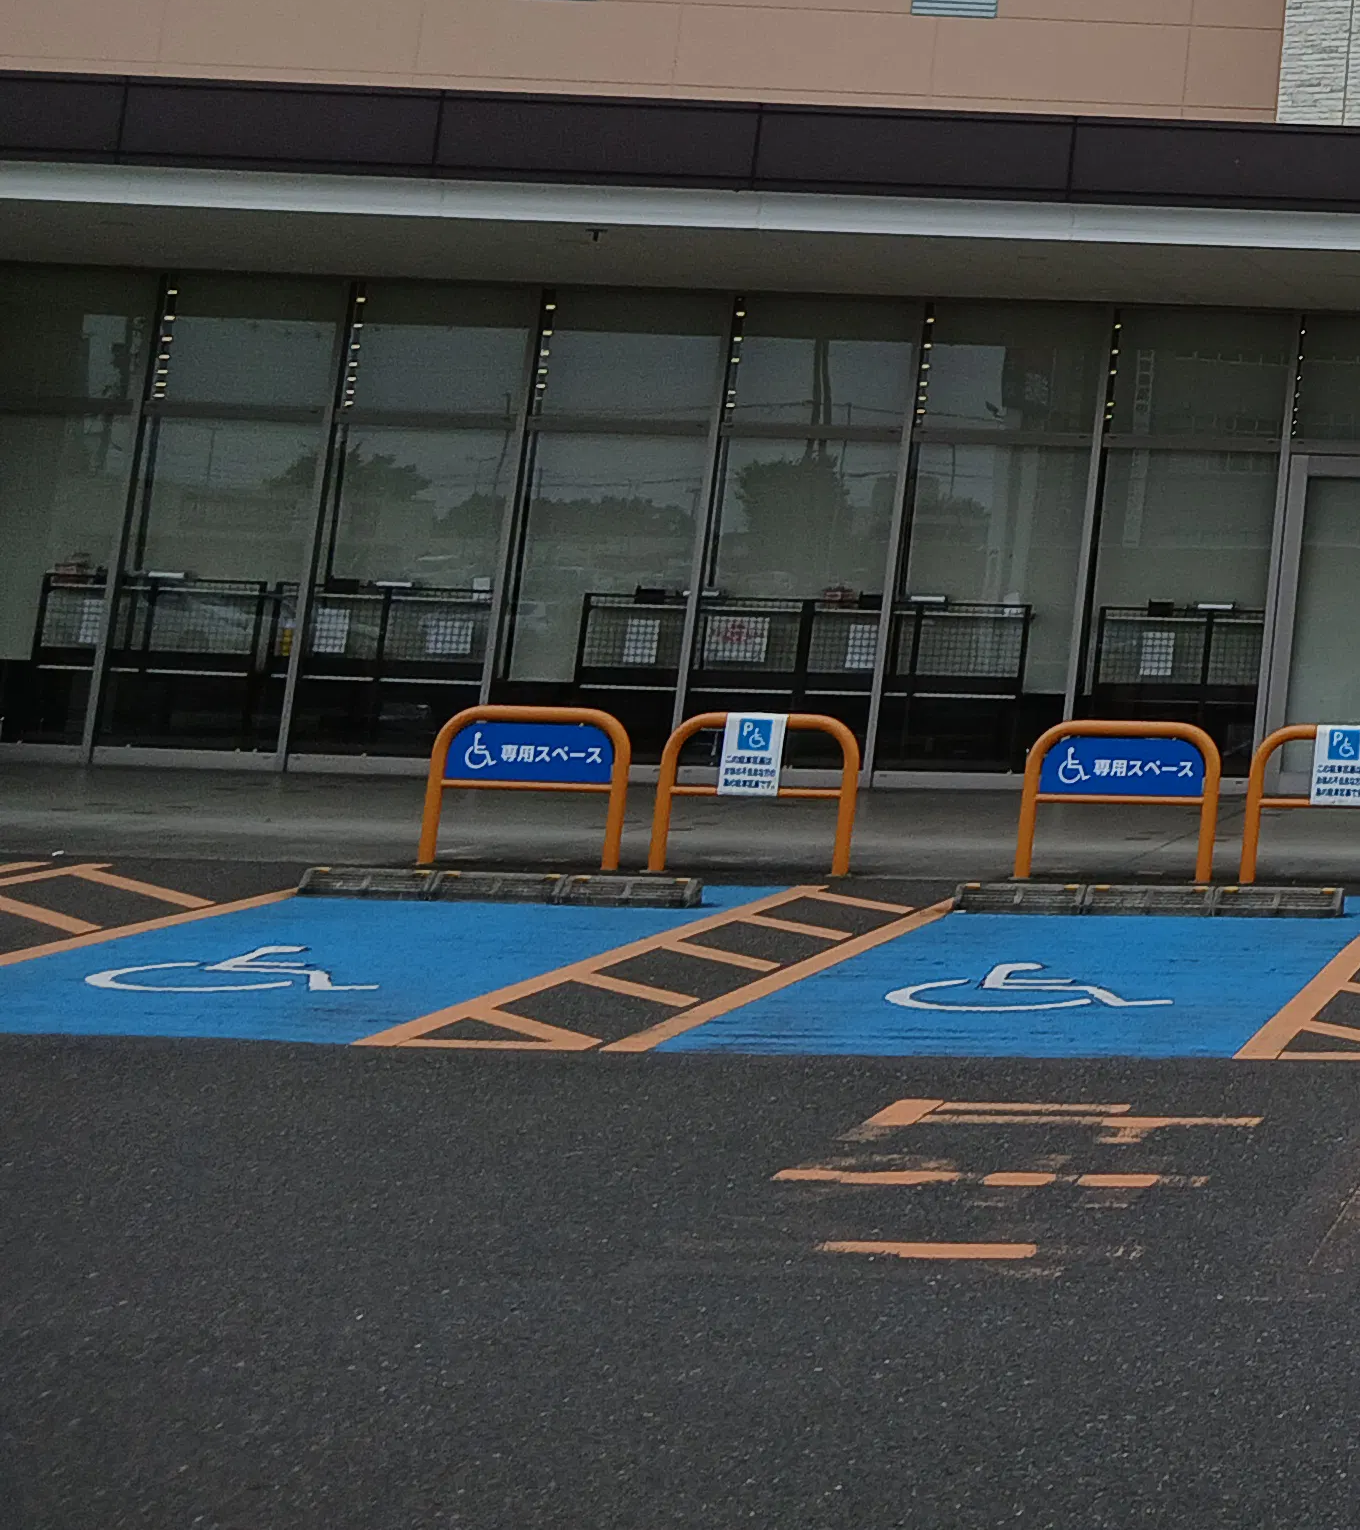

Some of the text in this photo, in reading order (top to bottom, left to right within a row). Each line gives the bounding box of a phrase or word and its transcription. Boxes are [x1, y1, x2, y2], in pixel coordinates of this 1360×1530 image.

[500, 744, 603, 764] 専用スペース
[1093, 759, 1195, 778] 専用スペース
